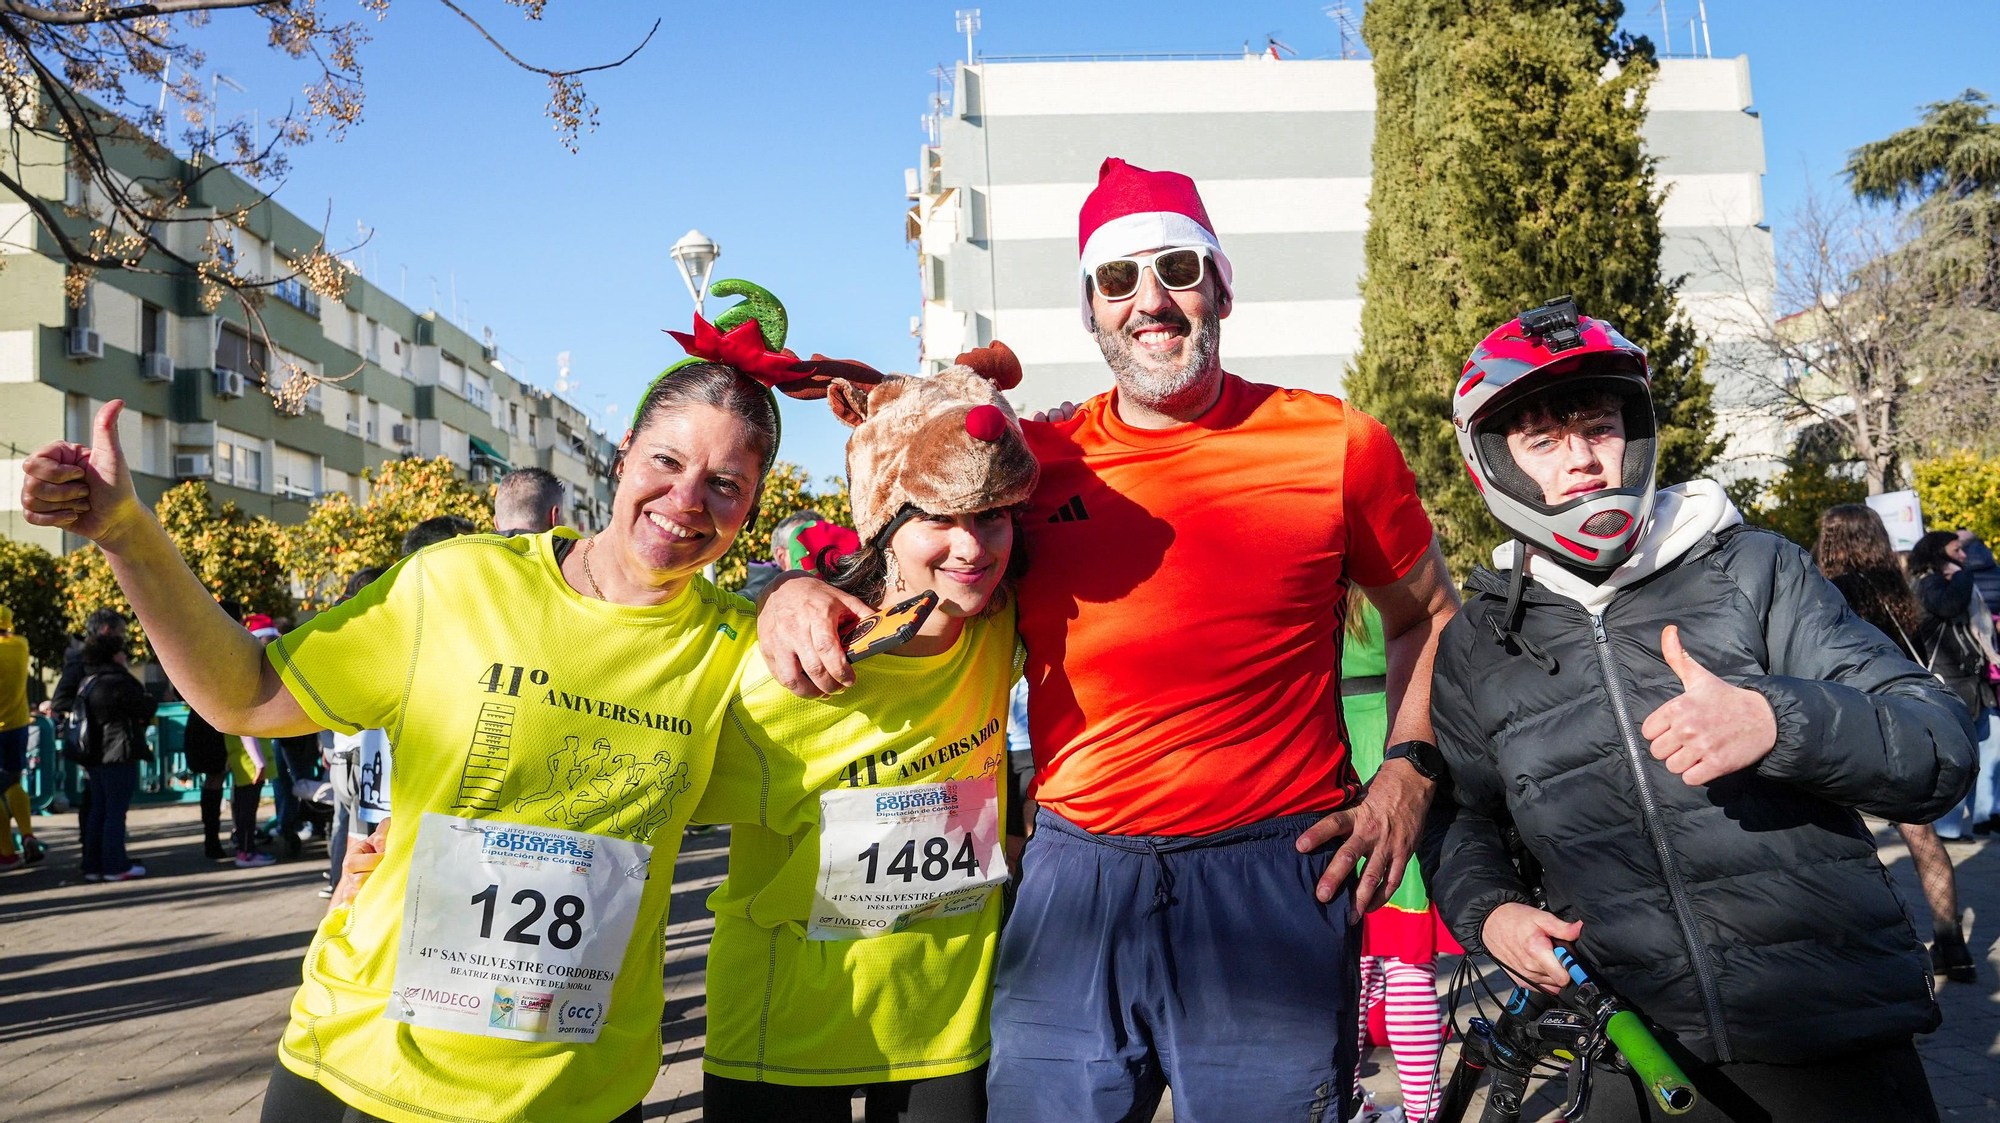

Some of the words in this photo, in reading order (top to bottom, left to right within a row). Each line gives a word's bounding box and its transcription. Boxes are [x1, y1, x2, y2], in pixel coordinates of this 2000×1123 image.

[542, 689, 692, 736] ANIVERSARIO
[899, 718, 999, 779] ANIVERSARIO
[876, 790, 947, 804] carreras
[910, 786, 946, 794] PROVINCIAL
[876, 794, 958, 812] populares
[876, 809, 919, 817] Diputación
[932, 804, 959, 813] Córdoba
[484, 830, 578, 849] carreras
[485, 825, 525, 835] CIRCUITO
[527, 830, 578, 841] PROVINCIAL
[481, 848, 534, 860] Diputación
[552, 856, 592, 868] Córdoba
[483, 838, 594, 860] populares
[858, 831, 979, 884] 1484
[849, 894, 872, 902] SAN
[877, 892, 936, 902] SILVESTRE
[471, 884, 585, 950] 128
[835, 918, 887, 928] IMDECO
[440, 949, 467, 963] SAN
[469, 954, 544, 974] SILVESTRE
[547, 964, 615, 981] CORDOBESA
[450, 967, 489, 980] BEATRIZ
[490, 973, 547, 988] BENAVENTE
[548, 981, 565, 990] DEL
[566, 983, 592, 991] MORAL
[421, 988, 481, 1009] IMDECO
[568, 1006, 595, 1019] GCC
[575, 1027, 595, 1035] EVENTS
